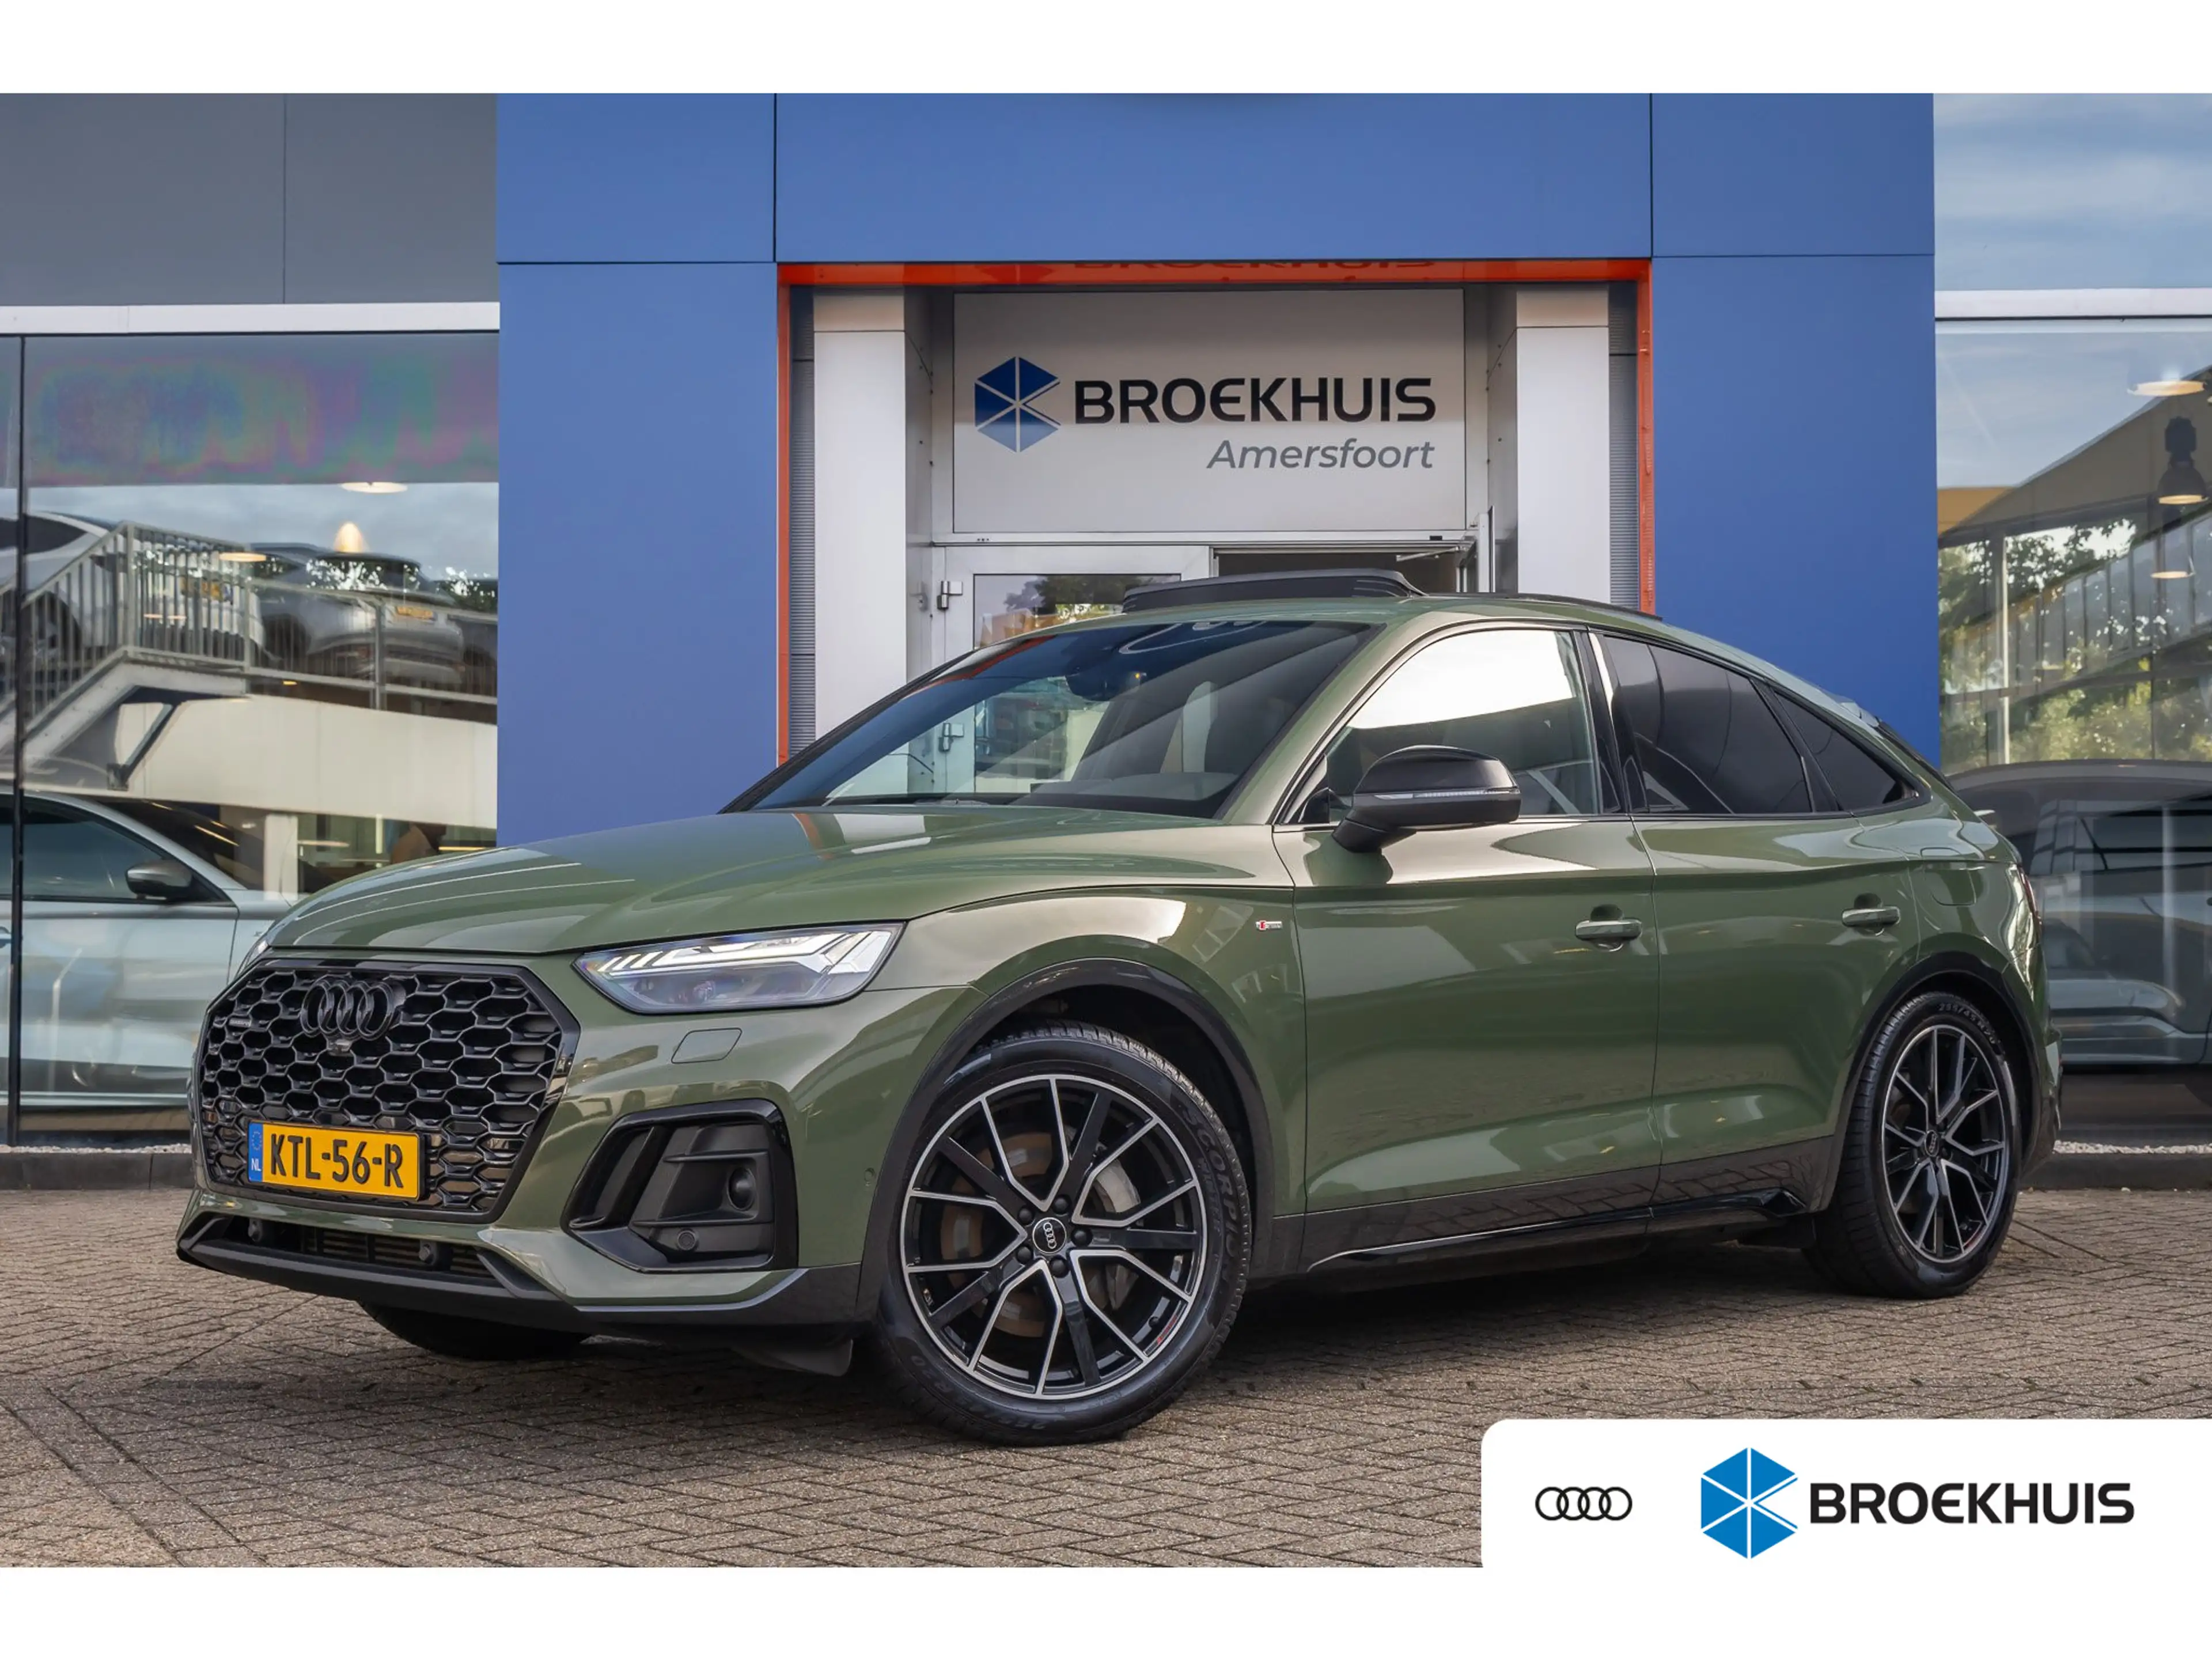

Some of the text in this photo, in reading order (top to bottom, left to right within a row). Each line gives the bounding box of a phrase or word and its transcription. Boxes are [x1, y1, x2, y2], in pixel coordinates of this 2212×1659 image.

[1075, 377, 1436, 424] BROEKHUIS
[1207, 438, 1435, 469] Amersfoort
[251, 1157, 261, 1172] NL
[270, 1132, 403, 1190] KTL-56-R
